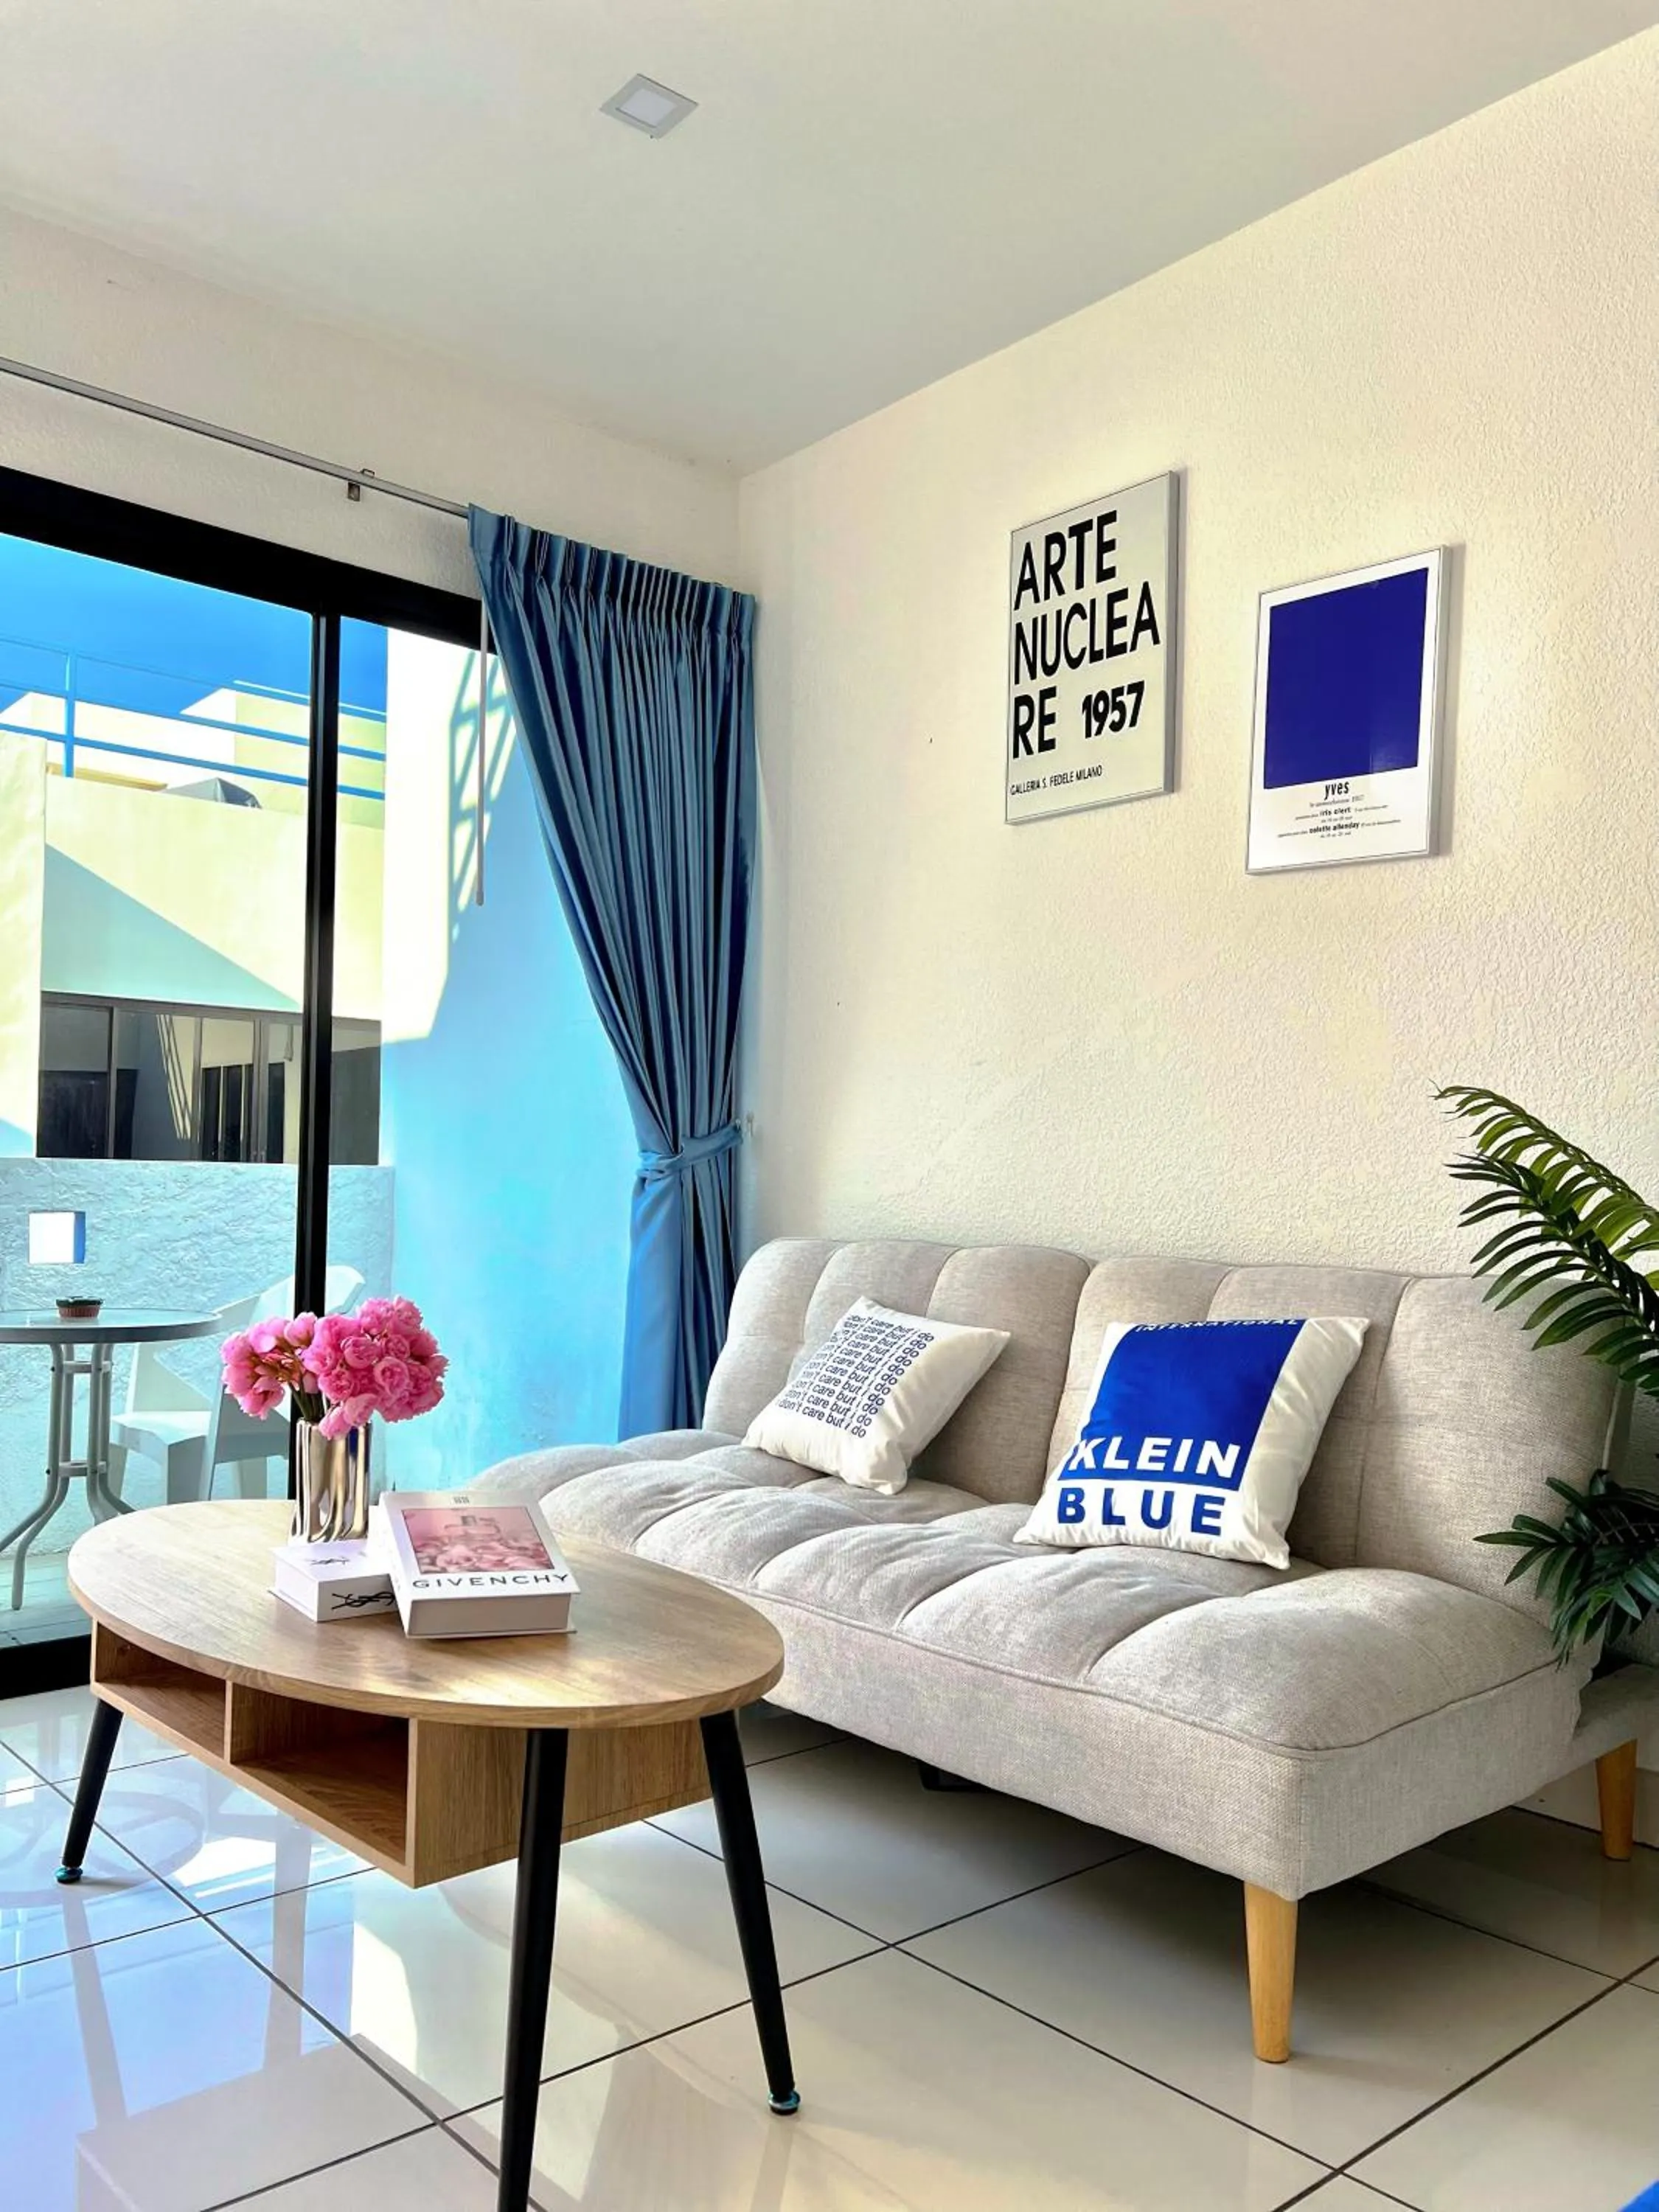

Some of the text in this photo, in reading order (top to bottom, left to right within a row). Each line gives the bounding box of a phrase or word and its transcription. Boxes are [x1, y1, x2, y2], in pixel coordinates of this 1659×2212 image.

[1014, 509, 1117, 611] ARTE
[1014, 580, 1161, 686] NUCLEA
[1012, 680, 1145, 759] RE 1957
[1010, 779, 1040, 796] GALLERIA
[1049, 770, 1074, 787] FEDELE
[1076, 764, 1103, 781] MILANO
[1324, 781, 1350, 801] yves
[847, 1340, 870, 1350] care
[870, 1345, 891, 1356] but
[894, 1355, 912, 1366] do
[902, 1347, 919, 1358] do
[910, 1339, 927, 1350] do
[917, 1332, 934, 1343] do
[832, 1356, 855, 1368] care
[855, 1361, 876, 1375] but
[880, 1373, 897, 1385] do
[840, 1348, 863, 1358] care
[862, 1353, 883, 1365] but
[887, 1364, 905, 1376] do
[818, 1374, 841, 1387] care
[841, 1380, 862, 1395] but
[868, 1393, 885, 1406] do
[825, 1365, 849, 1377] care
[848, 1370, 869, 1384] but
[874, 1382, 891, 1396] do
[807, 1395, 830, 1409] care
[830, 1401, 851, 1416] but
[857, 1413, 872, 1427] do
[813, 1385, 835, 1397] care
[836, 1391, 857, 1405] but
[862, 1403, 878, 1415] do
[802, 1406, 825, 1421] care
[826, 1412, 844, 1428] but
[851, 1425, 866, 1439] do
[1068, 1436, 1240, 1478] KLEIN
[1057, 1487, 1225, 1537] BLUE
[412, 1573, 569, 1589] GIVENCHY
